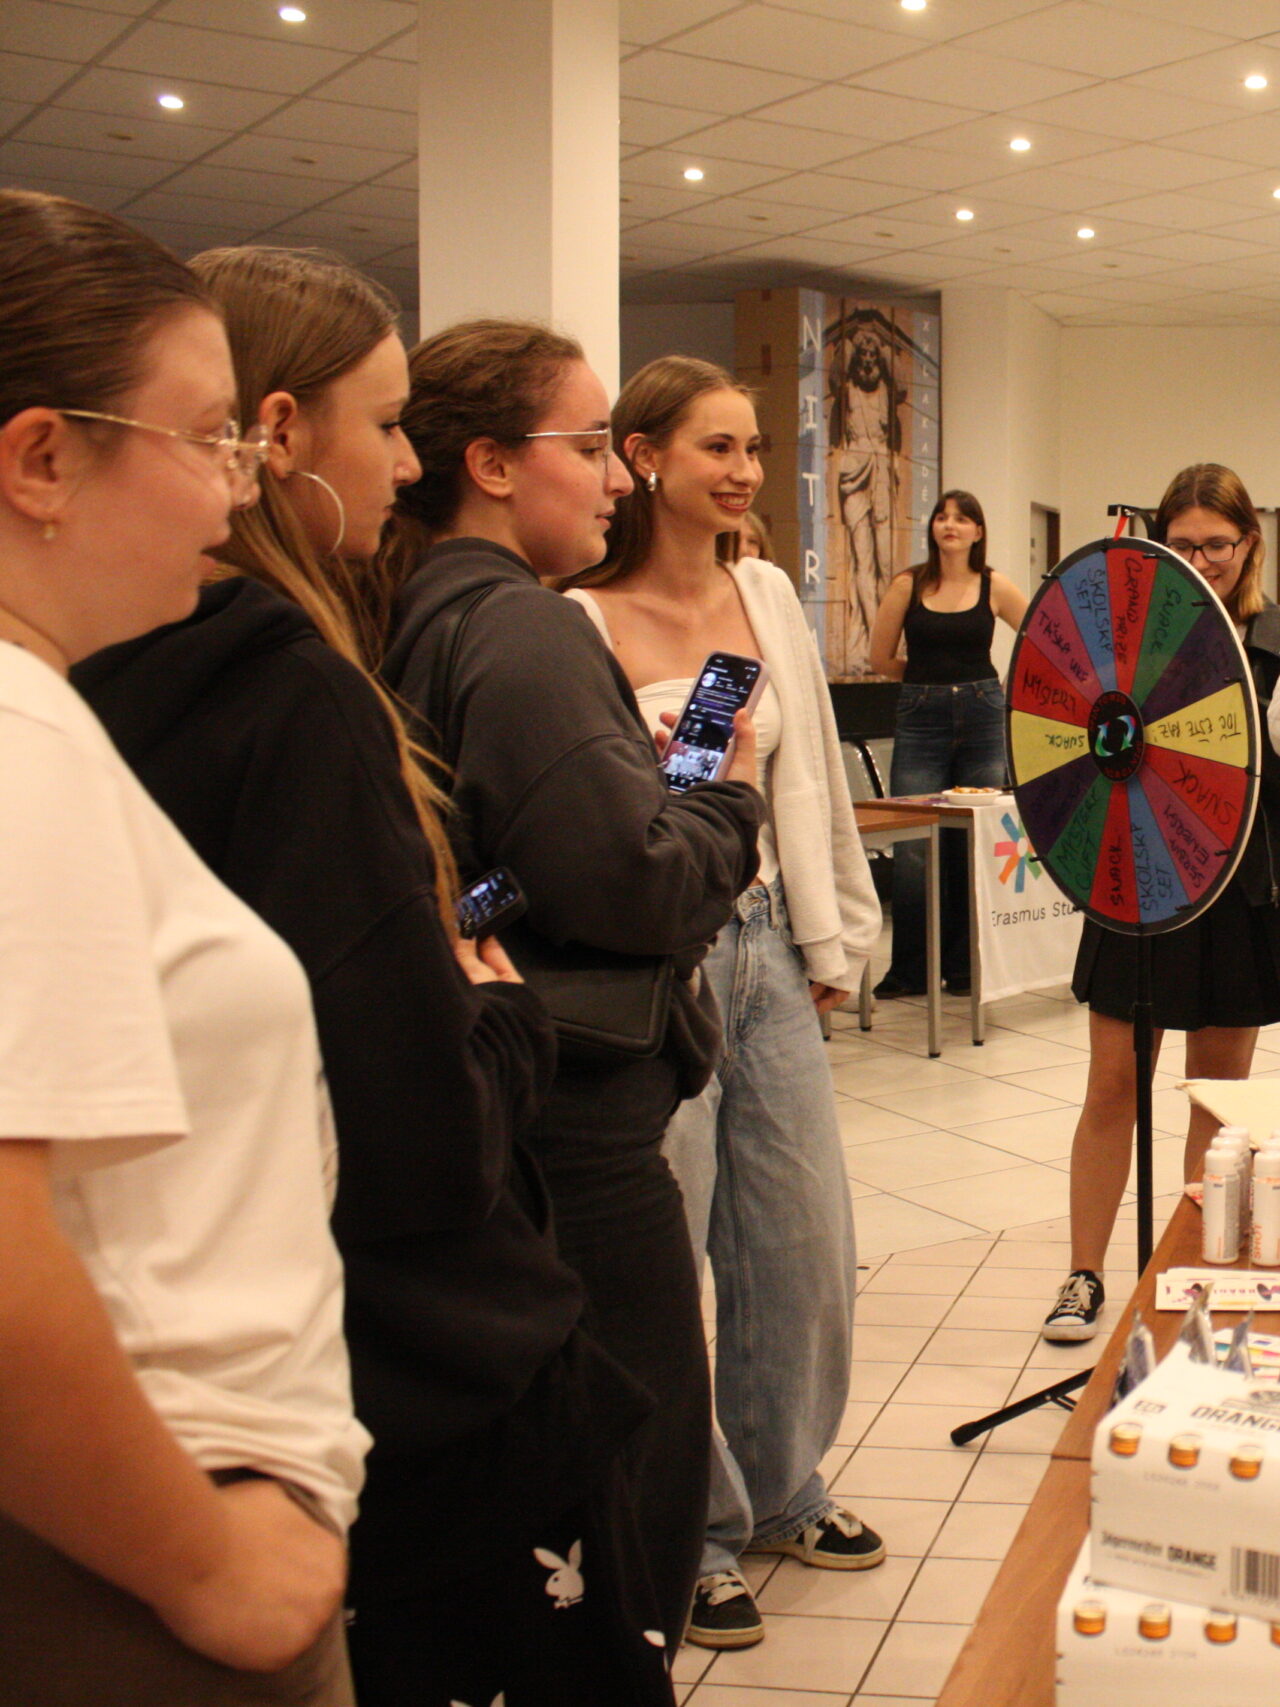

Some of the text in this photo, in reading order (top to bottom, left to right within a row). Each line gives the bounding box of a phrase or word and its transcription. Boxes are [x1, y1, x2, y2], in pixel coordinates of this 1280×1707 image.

[1075, 579, 1092, 612] SET
[1173, 759, 1238, 825] SNACK
[1111, 834, 1126, 906] SNACK
[1157, 864, 1173, 899] SET
